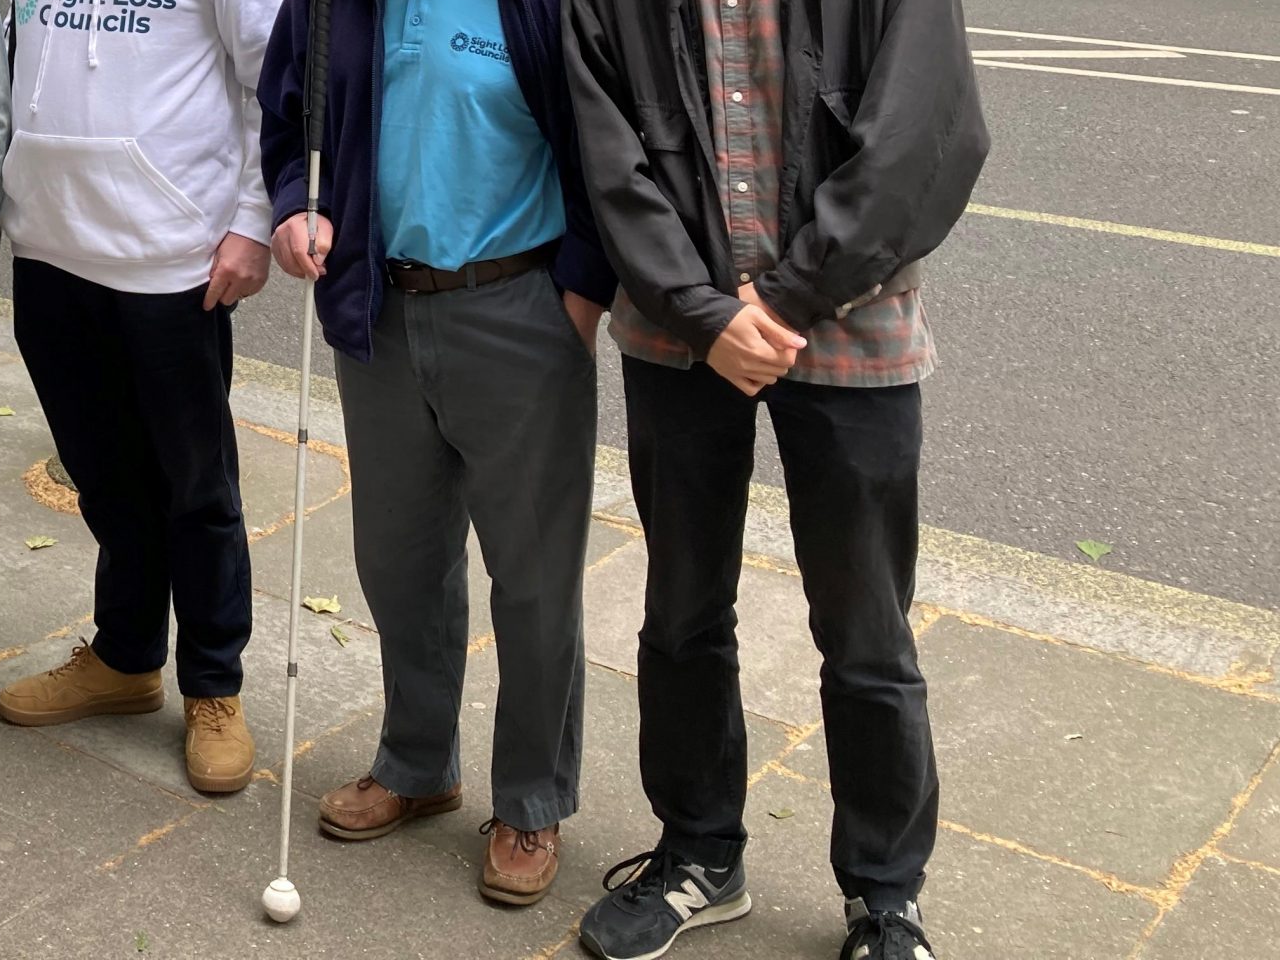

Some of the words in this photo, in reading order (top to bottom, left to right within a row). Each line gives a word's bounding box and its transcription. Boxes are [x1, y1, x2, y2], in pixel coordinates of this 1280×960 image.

[39, 4, 151, 34] Councils
[470, 36, 497, 50] Sight
[468, 45, 510, 63] Councils
